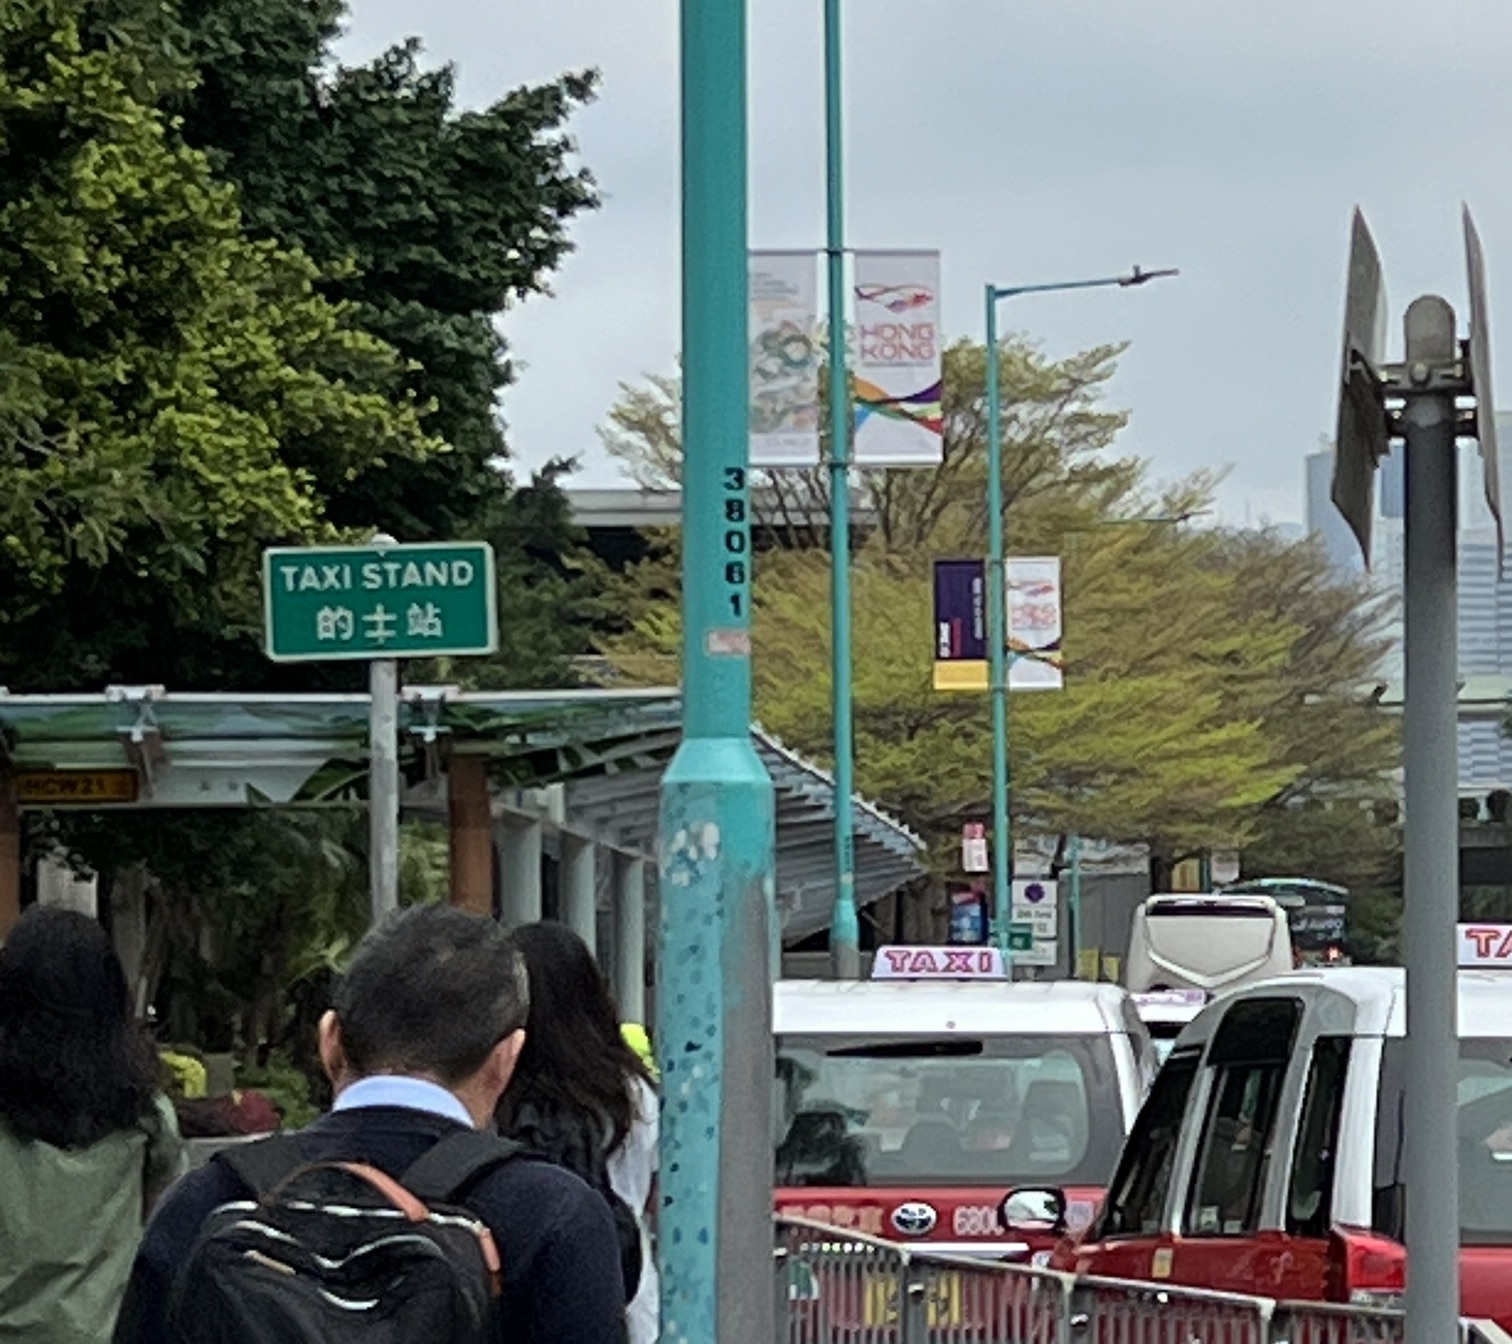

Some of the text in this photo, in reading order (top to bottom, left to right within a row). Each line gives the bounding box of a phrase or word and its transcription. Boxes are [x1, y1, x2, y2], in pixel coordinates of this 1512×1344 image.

[723, 467, 745, 617] 38061
[280, 559, 474, 592] TAXI STAND
[316, 602, 443, 645] 的士站
[885, 950, 994, 973] TAXI
